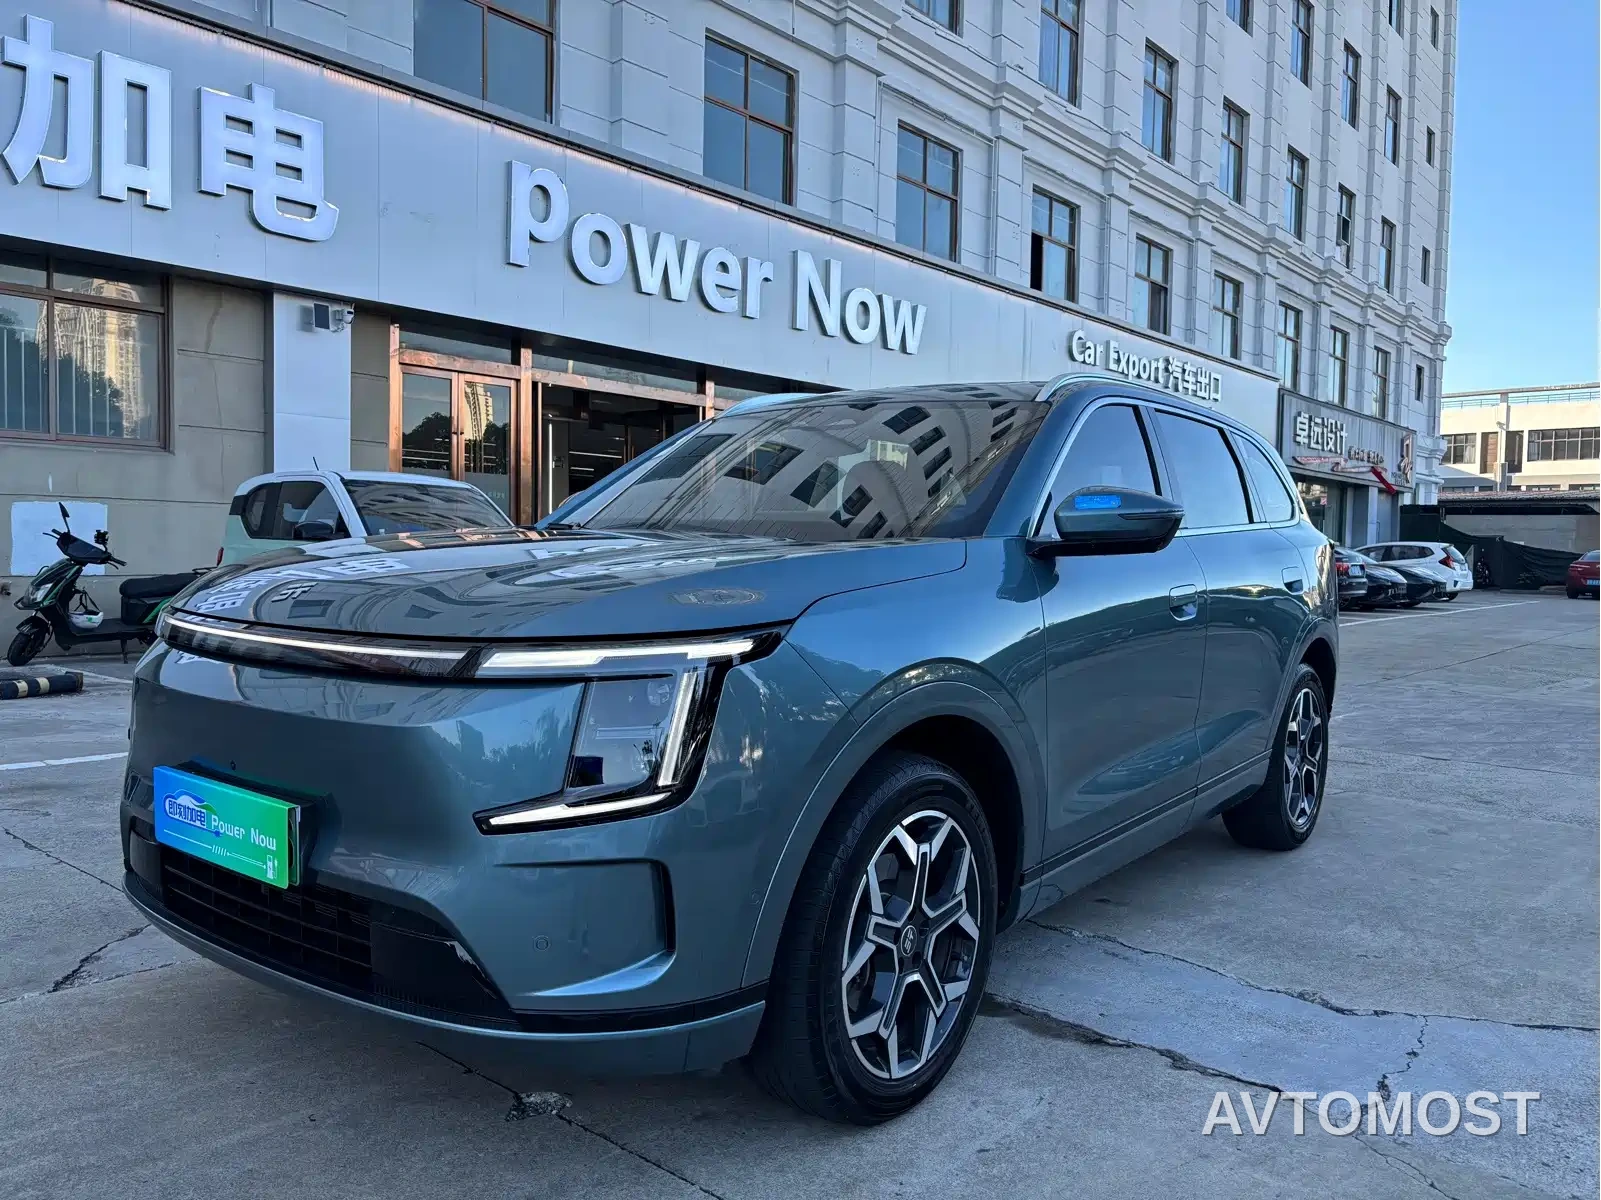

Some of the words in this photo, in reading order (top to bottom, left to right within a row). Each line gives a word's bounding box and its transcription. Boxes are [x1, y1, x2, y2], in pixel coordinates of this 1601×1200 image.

[1, 14, 340, 242] 加电
[792, 249, 927, 355] Now
[1069, 329, 1104, 367] Car
[1106, 339, 1164, 384] Export
[1165, 355, 1222, 402] 汽车出口
[1295, 411, 1348, 456] 卓远设计
[168, 799, 206, 827] 即刻加电
[211, 814, 246, 840] Power
[250, 827, 277, 851] Now
